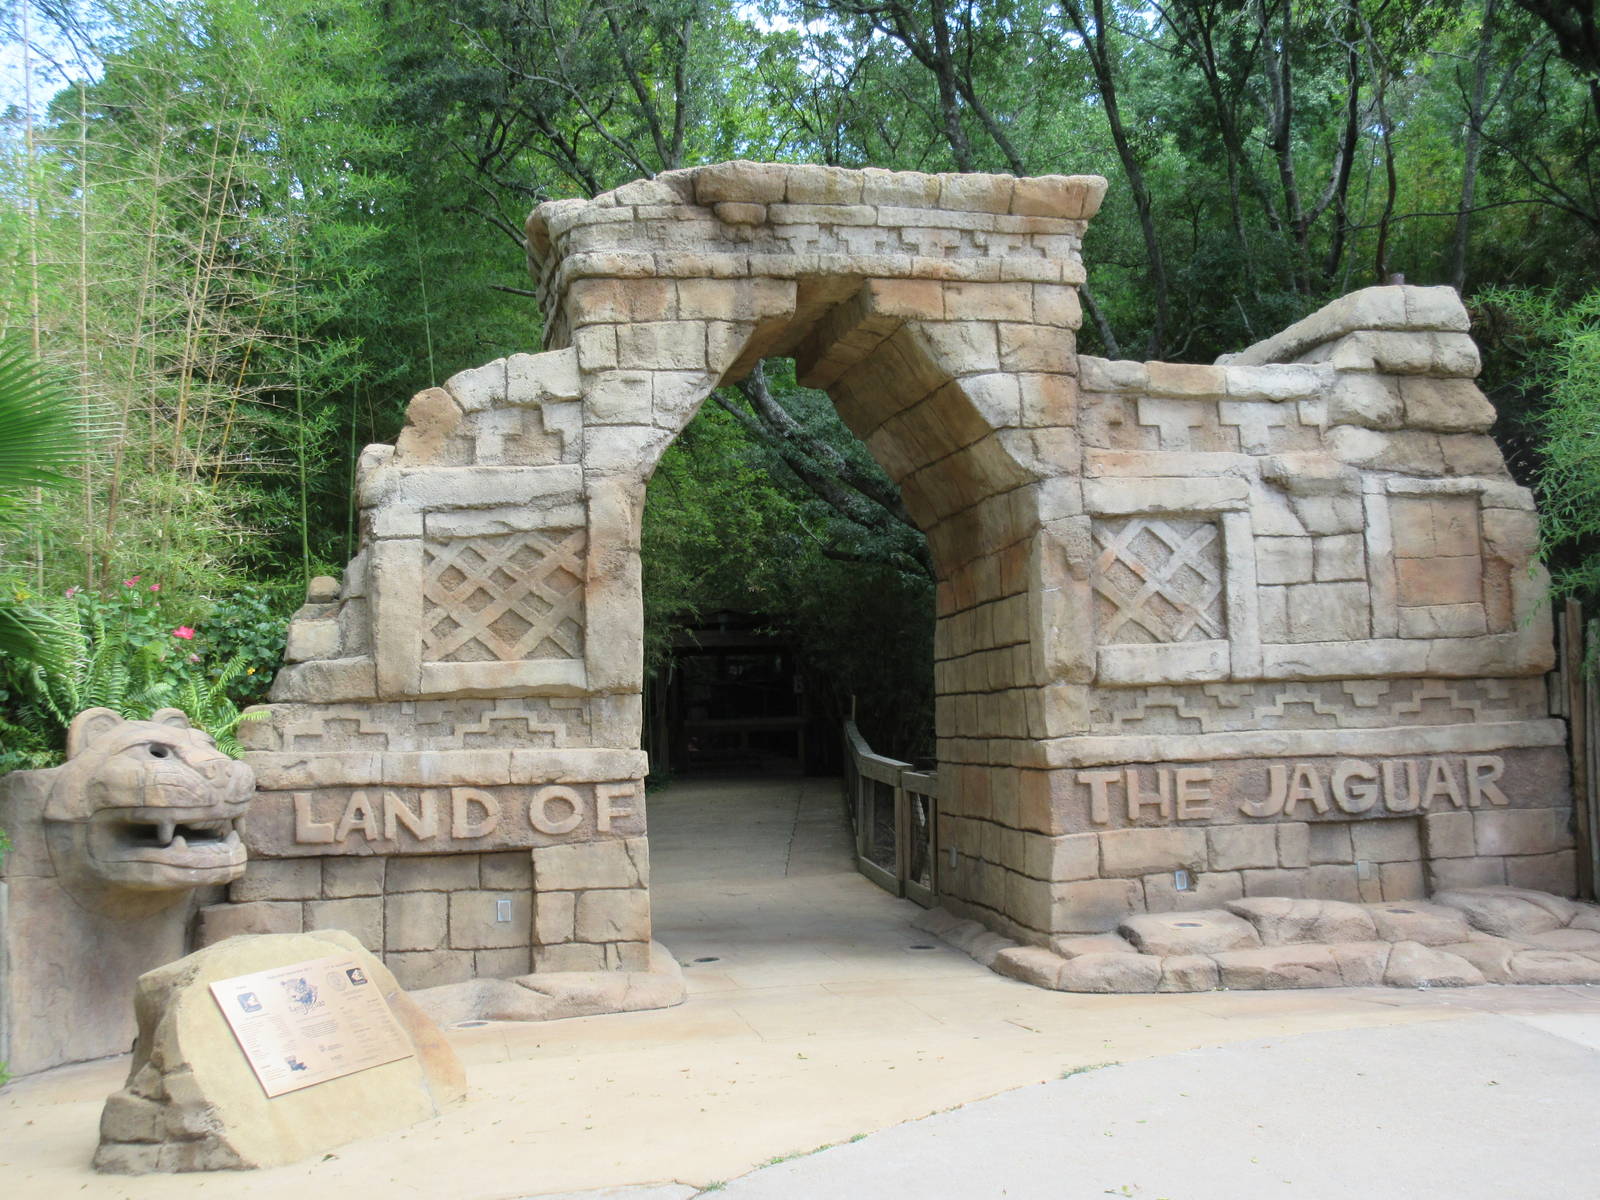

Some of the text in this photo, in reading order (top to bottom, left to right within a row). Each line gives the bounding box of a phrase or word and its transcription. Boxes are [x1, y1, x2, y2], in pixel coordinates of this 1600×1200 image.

[295, 785, 636, 842] LAND OF
[1077, 755, 1508, 824] THE JAGUAR
